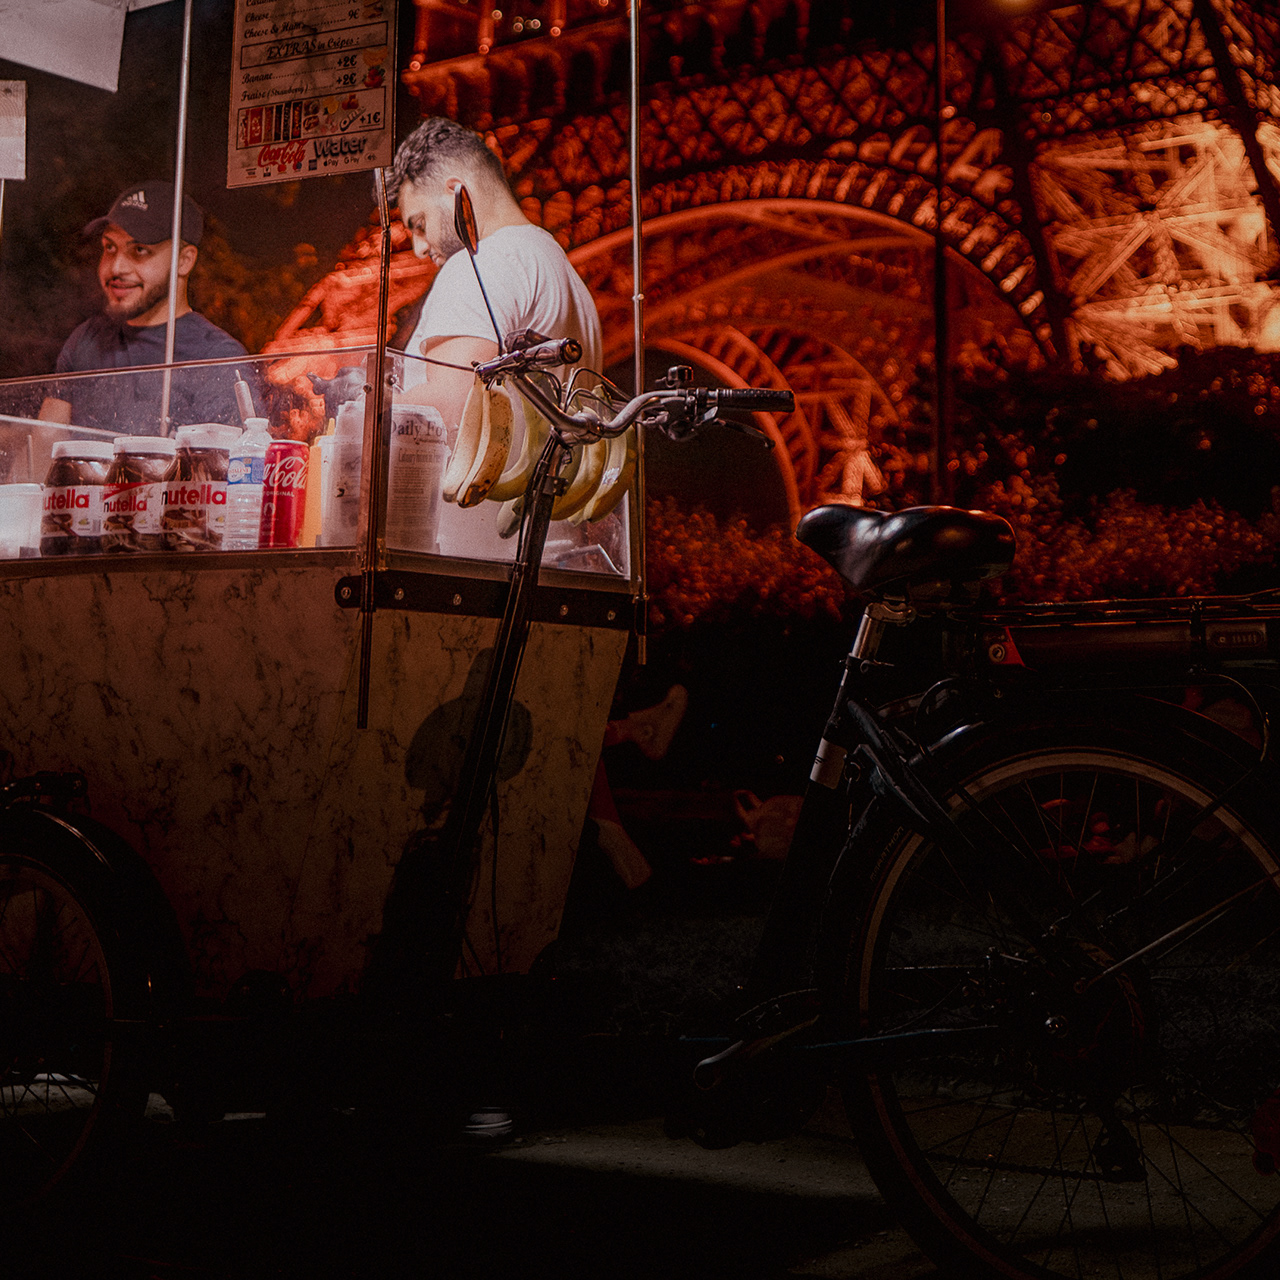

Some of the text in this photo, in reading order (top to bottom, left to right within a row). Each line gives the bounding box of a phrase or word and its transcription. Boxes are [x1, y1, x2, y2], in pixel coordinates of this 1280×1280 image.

[244, 28, 269, 39] Cheese
[348, 8, 360, 21] 9€
[245, 12, 270, 23] Cheese
[266, 39, 317, 61] EXTRAS
[241, 54, 358, 85] Banane +2€
[241, 90, 266, 102] Fraise
[336, 72, 357, 86] +2€
[360, 111, 381, 124] +1€
[314, 137, 367, 159] Water
[43, 489, 90, 510] utella
[103, 495, 148, 512] nutella
[161, 484, 227, 505] nutella
